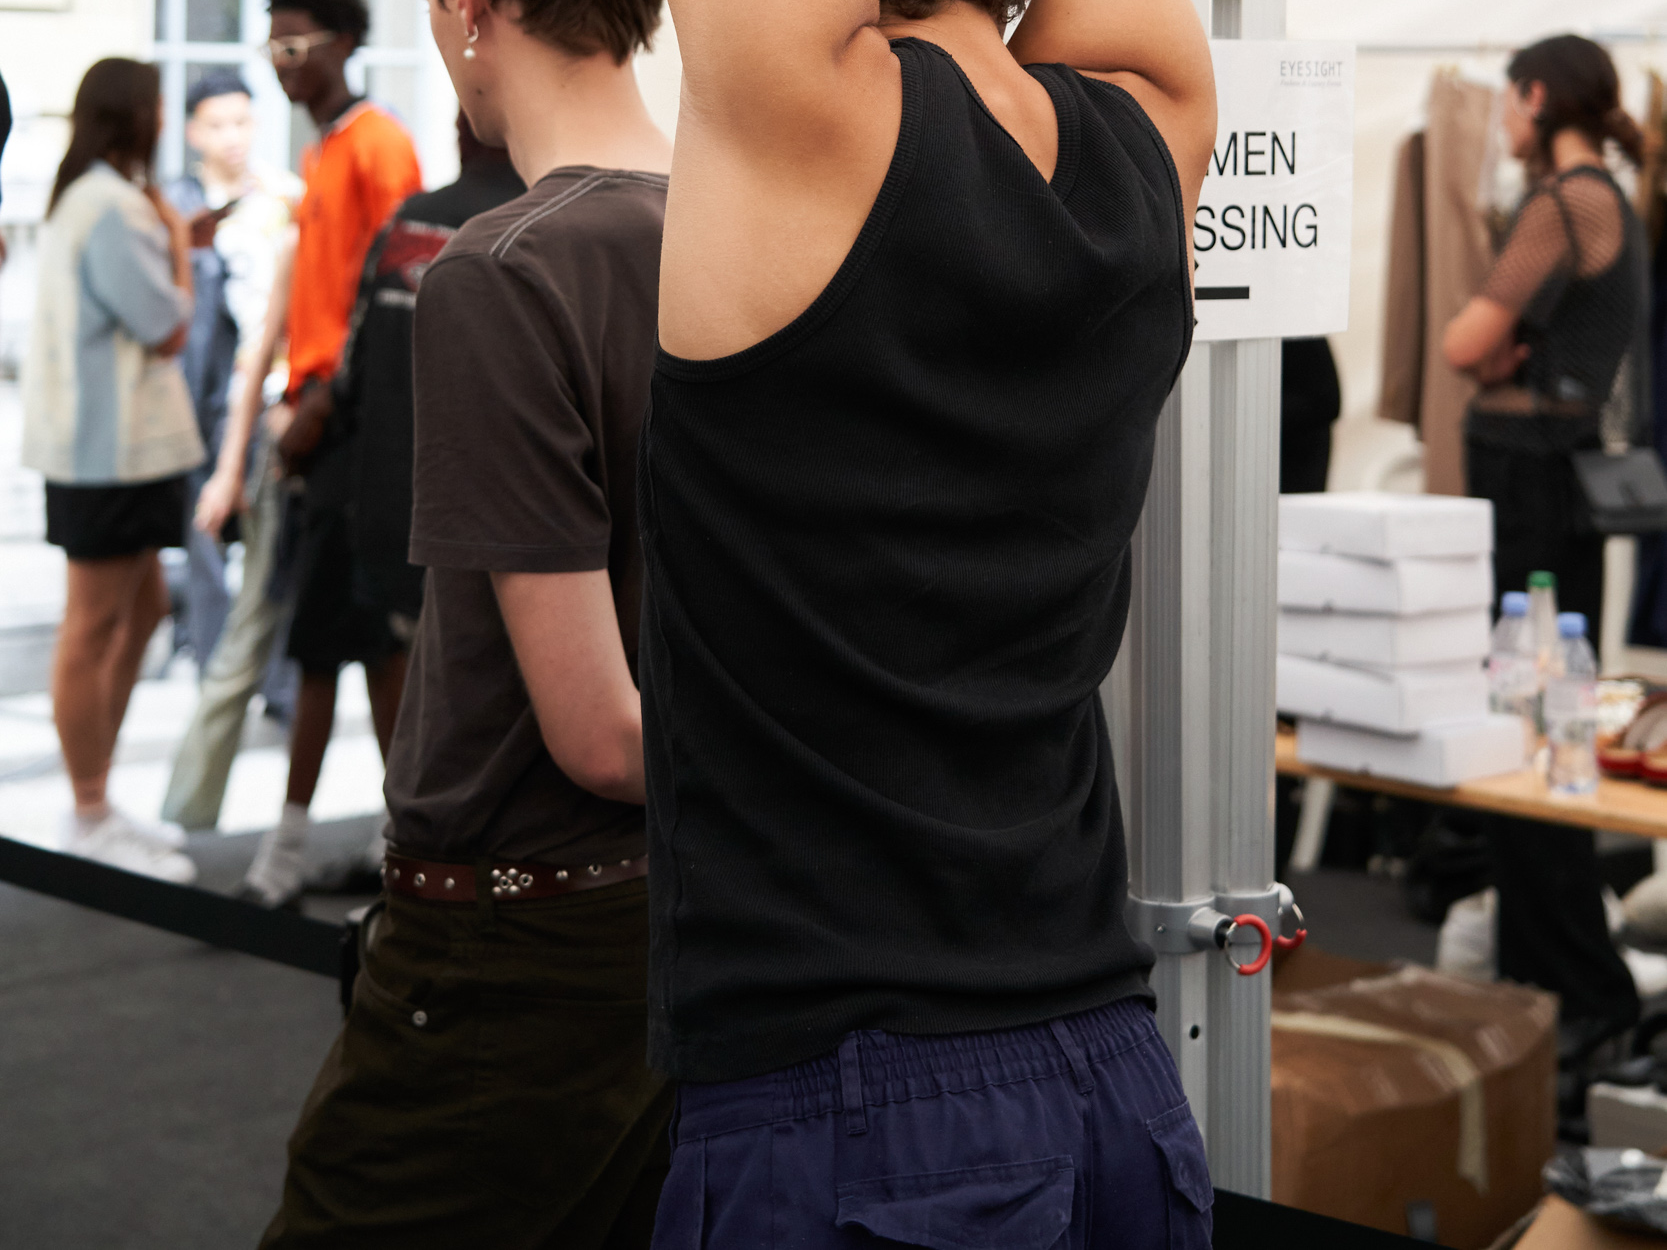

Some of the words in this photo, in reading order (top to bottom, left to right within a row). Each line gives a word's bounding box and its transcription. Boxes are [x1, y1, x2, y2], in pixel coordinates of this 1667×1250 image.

[1280, 60, 1343, 77] EYESIGHT
[1206, 131, 1296, 176] MEN
[1193, 203, 1318, 252] SSING
